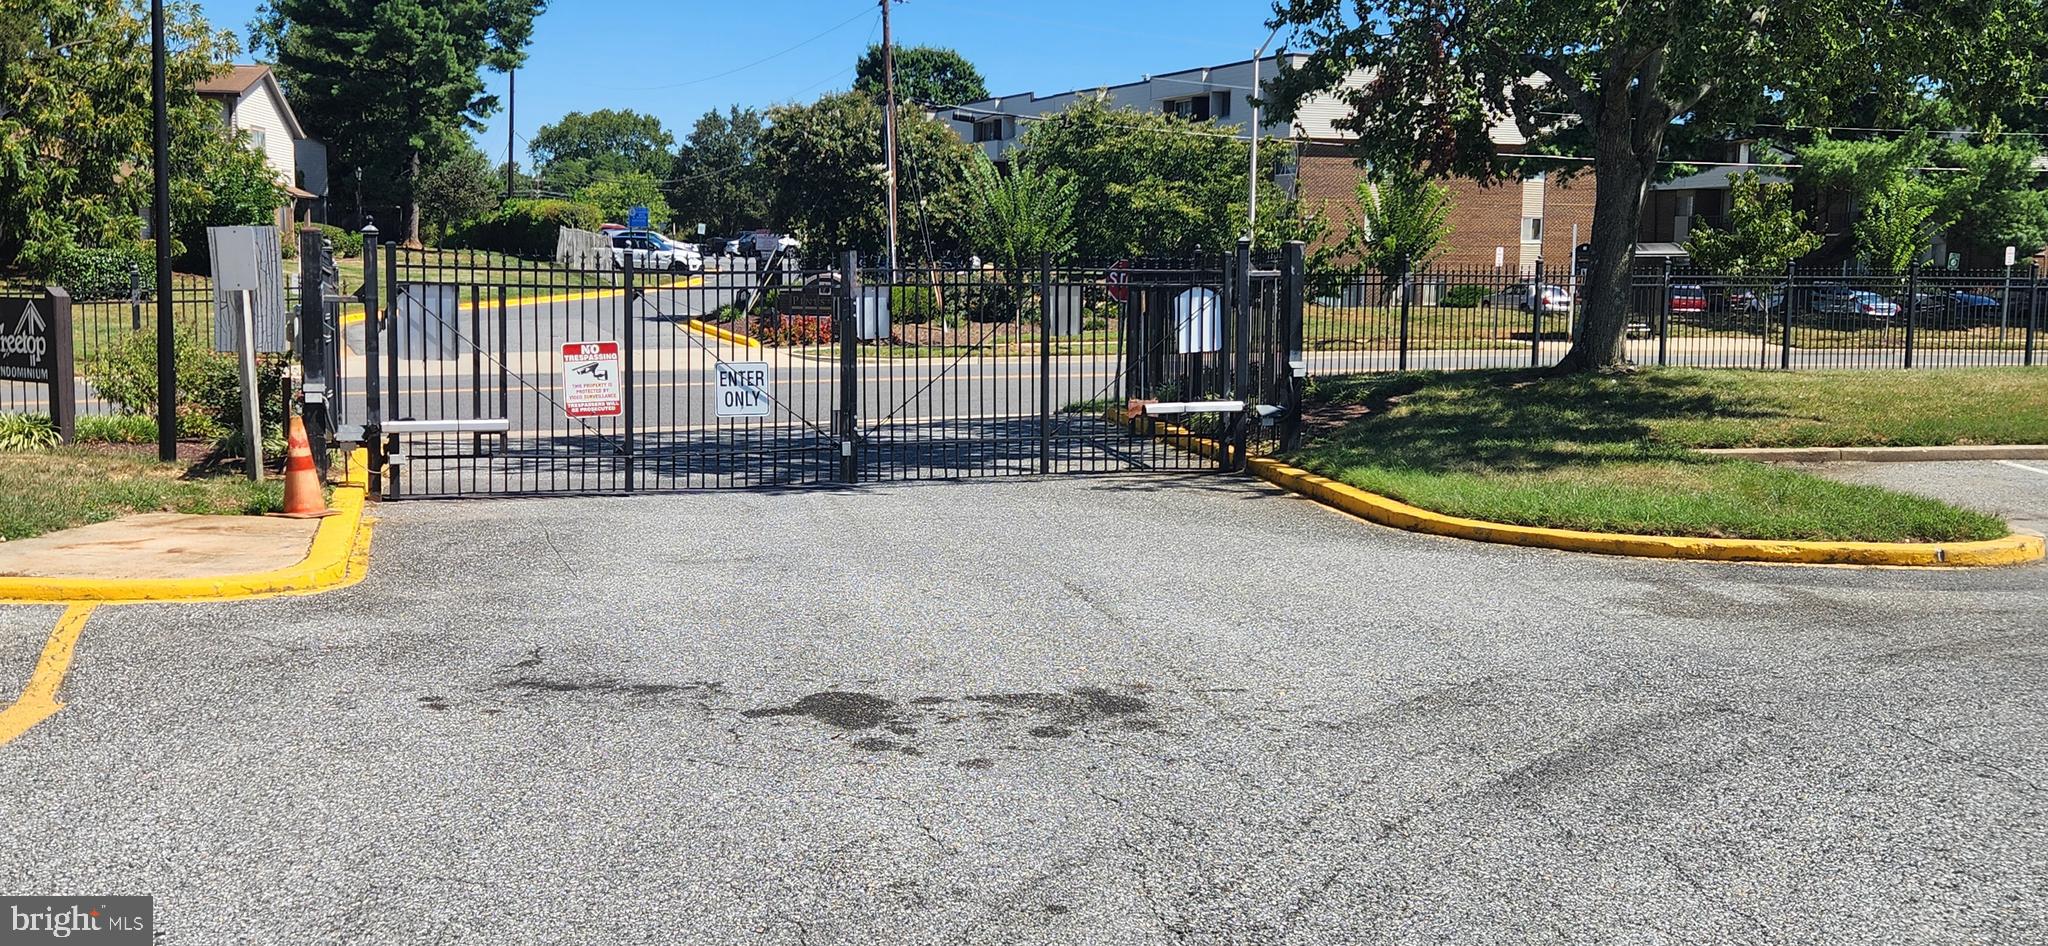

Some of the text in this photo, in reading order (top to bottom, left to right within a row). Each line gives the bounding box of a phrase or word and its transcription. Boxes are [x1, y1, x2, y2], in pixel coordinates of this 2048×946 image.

[580, 344, 600, 355] NO
[564, 353, 617, 361] TRESPASSING
[0, 365, 48, 379] NDOMINIUM
[720, 370, 765, 387] ENTER
[725, 390, 761, 407] ONLY
